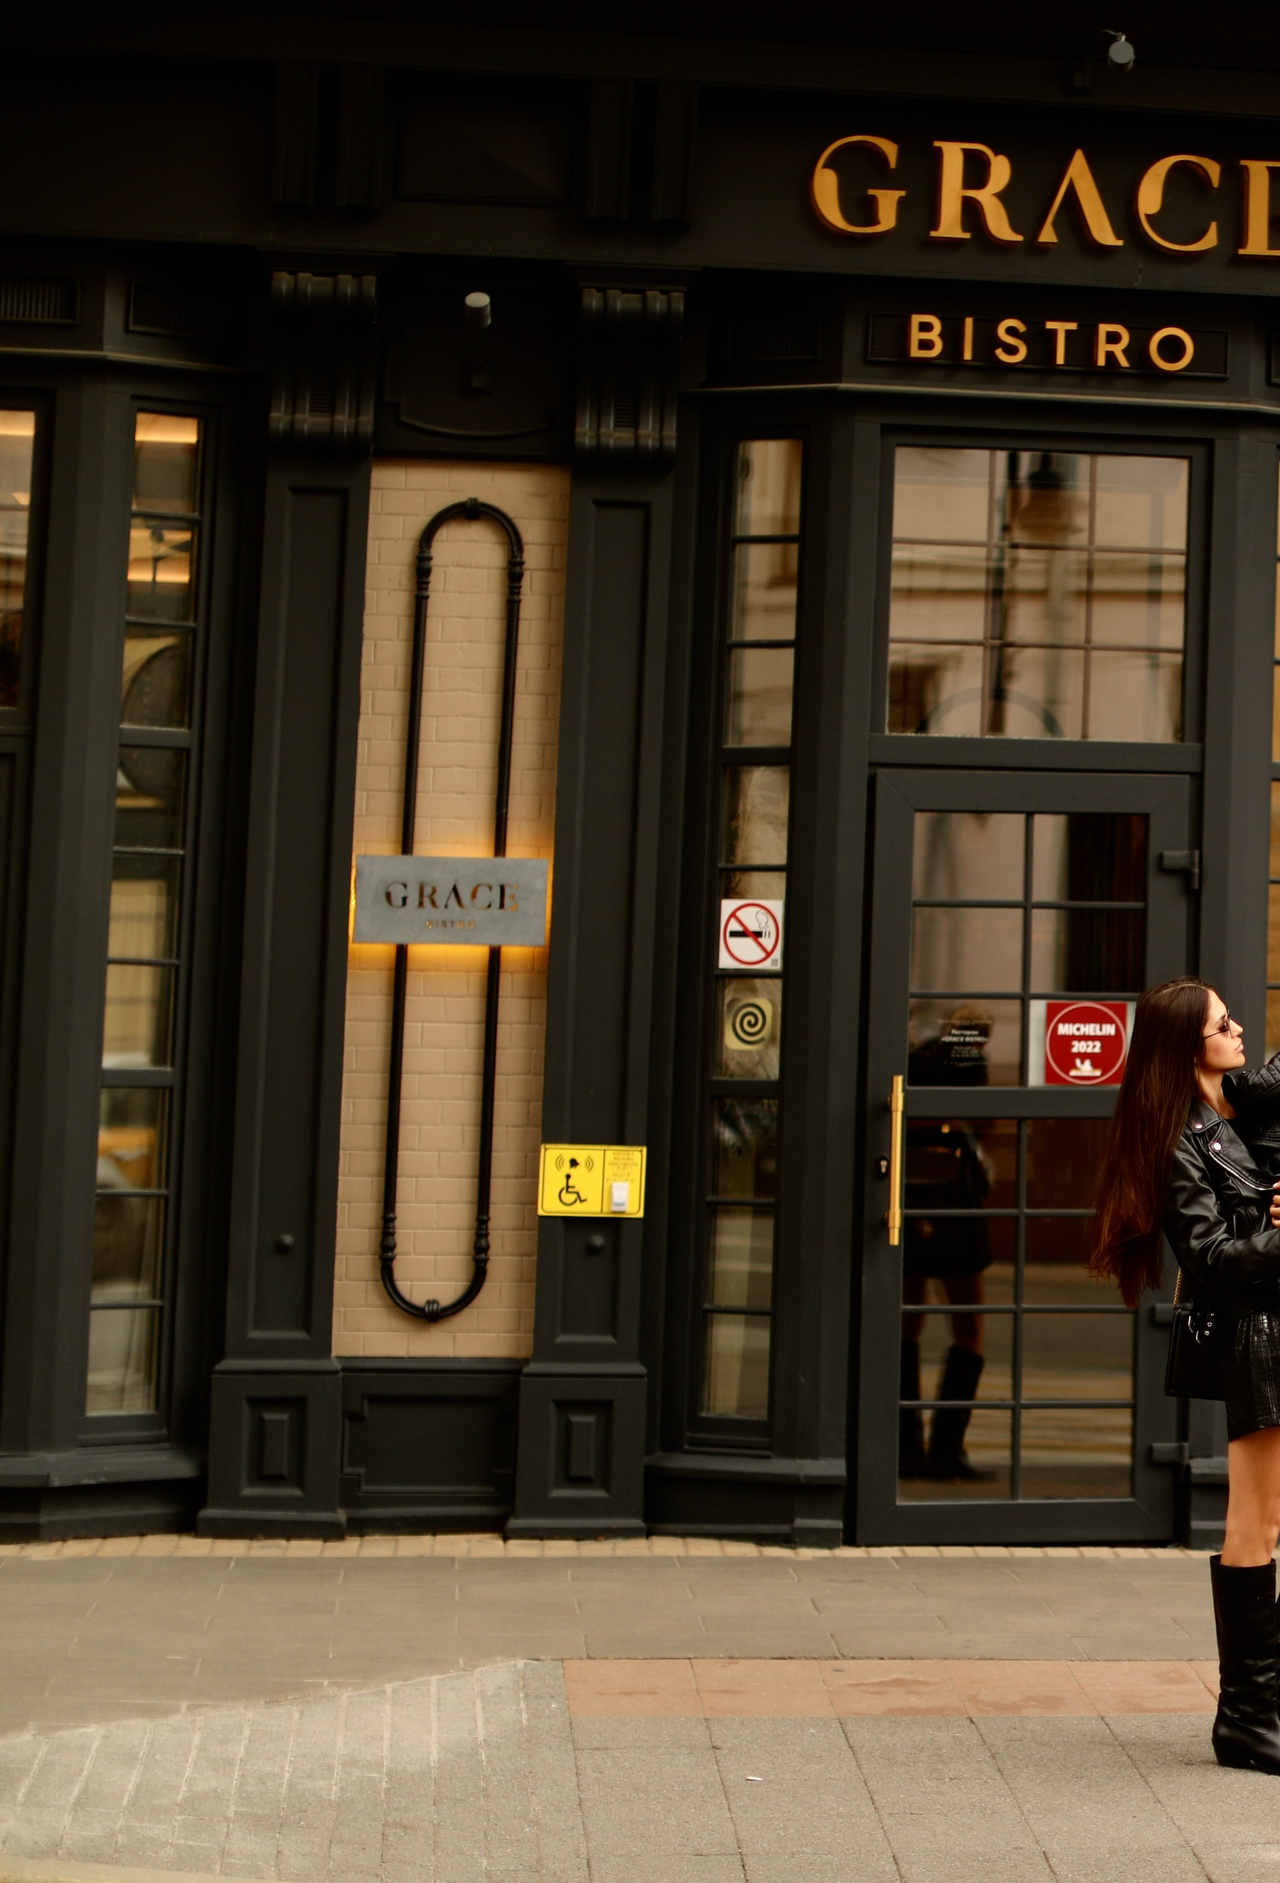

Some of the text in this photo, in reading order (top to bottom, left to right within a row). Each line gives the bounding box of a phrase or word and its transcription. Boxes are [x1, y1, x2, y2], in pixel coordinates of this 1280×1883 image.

[909, 313, 1195, 372] BISTRO
[384, 880, 520, 912] GRACE
[1057, 1022, 1116, 1036] MICHELIN
[1071, 1040, 1102, 1054] 2022
